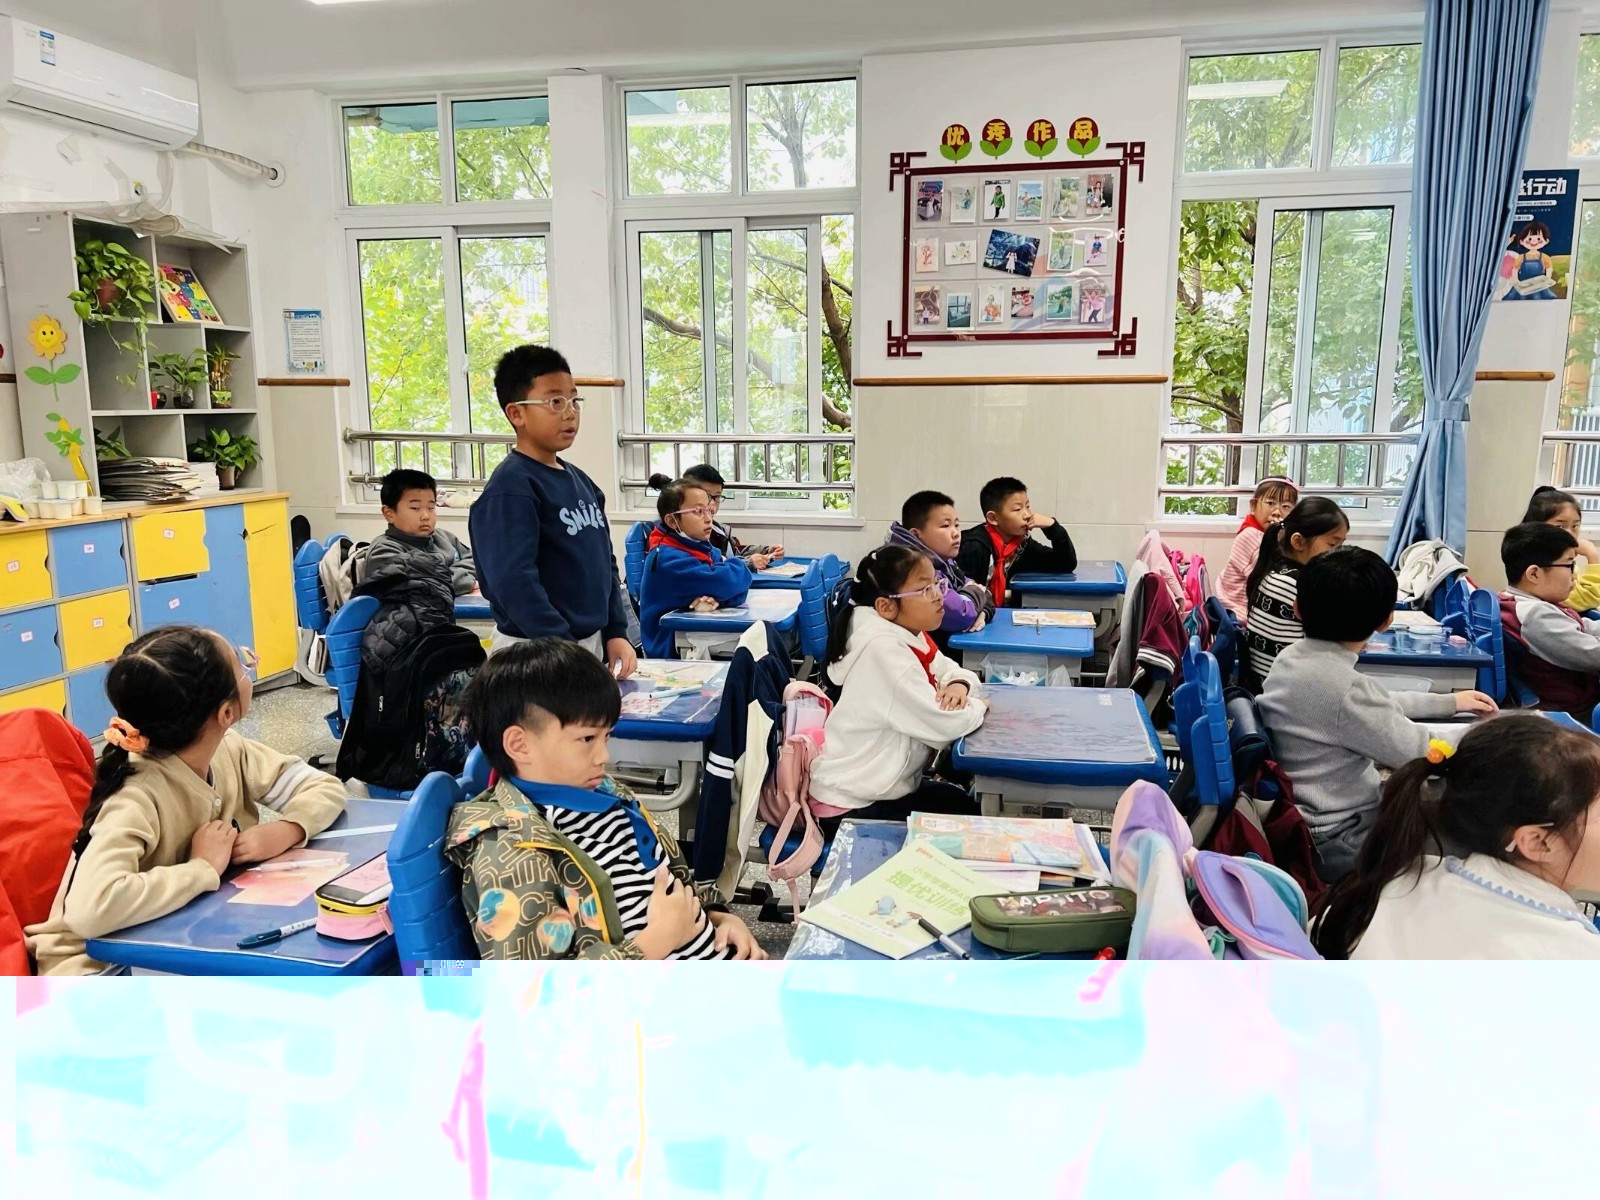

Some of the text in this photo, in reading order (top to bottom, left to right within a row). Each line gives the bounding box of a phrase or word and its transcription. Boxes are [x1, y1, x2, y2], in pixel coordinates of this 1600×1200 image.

[946, 119, 1093, 146] 优秀作品
[886, 869, 968, 917] 提优训练
